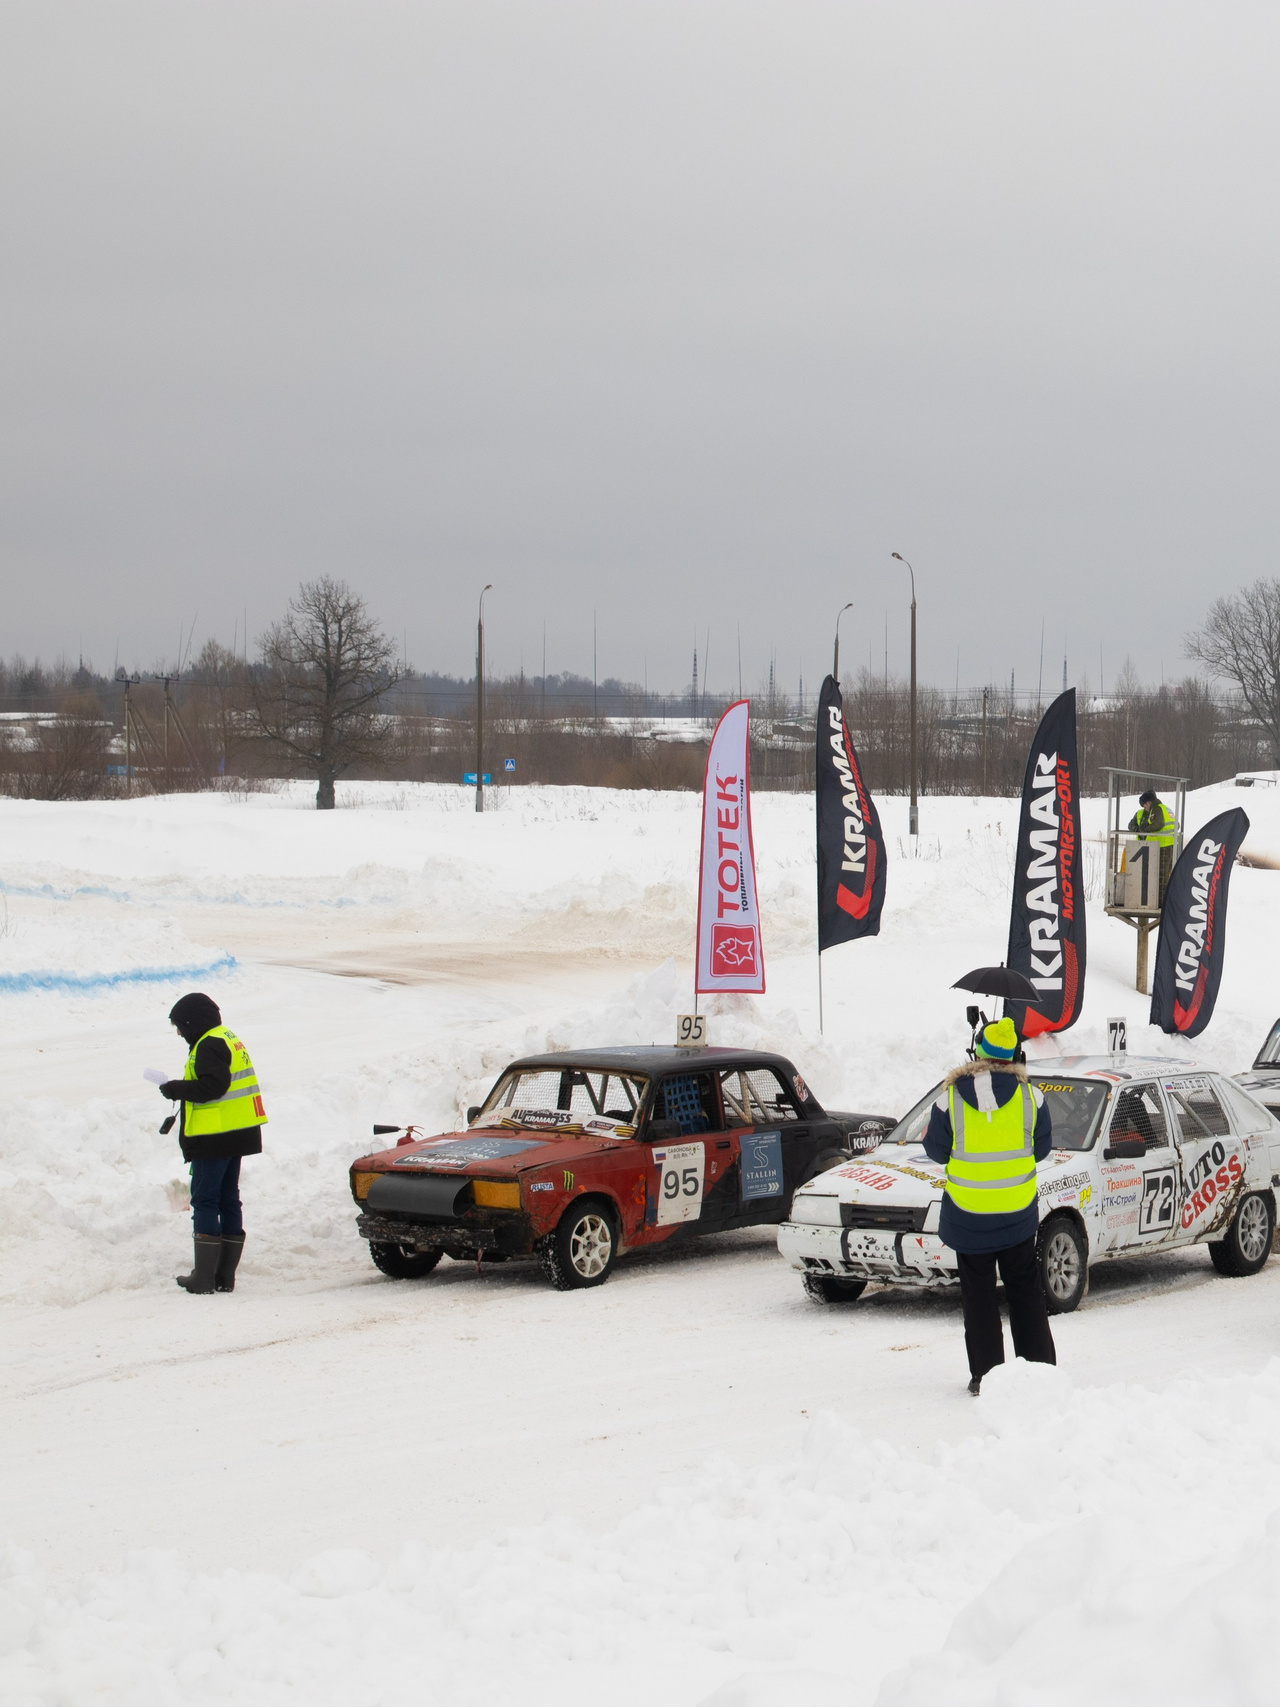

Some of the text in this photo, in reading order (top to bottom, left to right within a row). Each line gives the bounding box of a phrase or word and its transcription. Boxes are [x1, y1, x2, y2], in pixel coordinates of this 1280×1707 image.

[828, 706, 866, 873] KRAMAR
[842, 712, 872, 826] MOTORSPO
[717, 773, 739, 919] TOTEK
[1056, 752, 1075, 921] MOTORSPORT
[1025, 751, 1063, 990] KRAMAR
[1129, 846, 1149, 906] 1
[1175, 838, 1222, 991] KRAMAR
[1205, 843, 1226, 956] MOTORSPORT
[680, 1016, 704, 1041] 95
[1109, 1021, 1127, 1051] 72
[524, 1115, 556, 1124] KRAMAR
[853, 1136, 883, 1150] KRAM
[403, 1156, 466, 1165] KRAMAR
[532, 1183, 553, 1191] RUSTA
[664, 1168, 699, 1200] 95
[746, 1169, 777, 1180] STALLIN
[1107, 1176, 1142, 1192] Тракшина
[1183, 1141, 1226, 1199] AUTO
[1145, 1175, 1173, 1224] 72
[1181, 1154, 1242, 1229] CROSS
